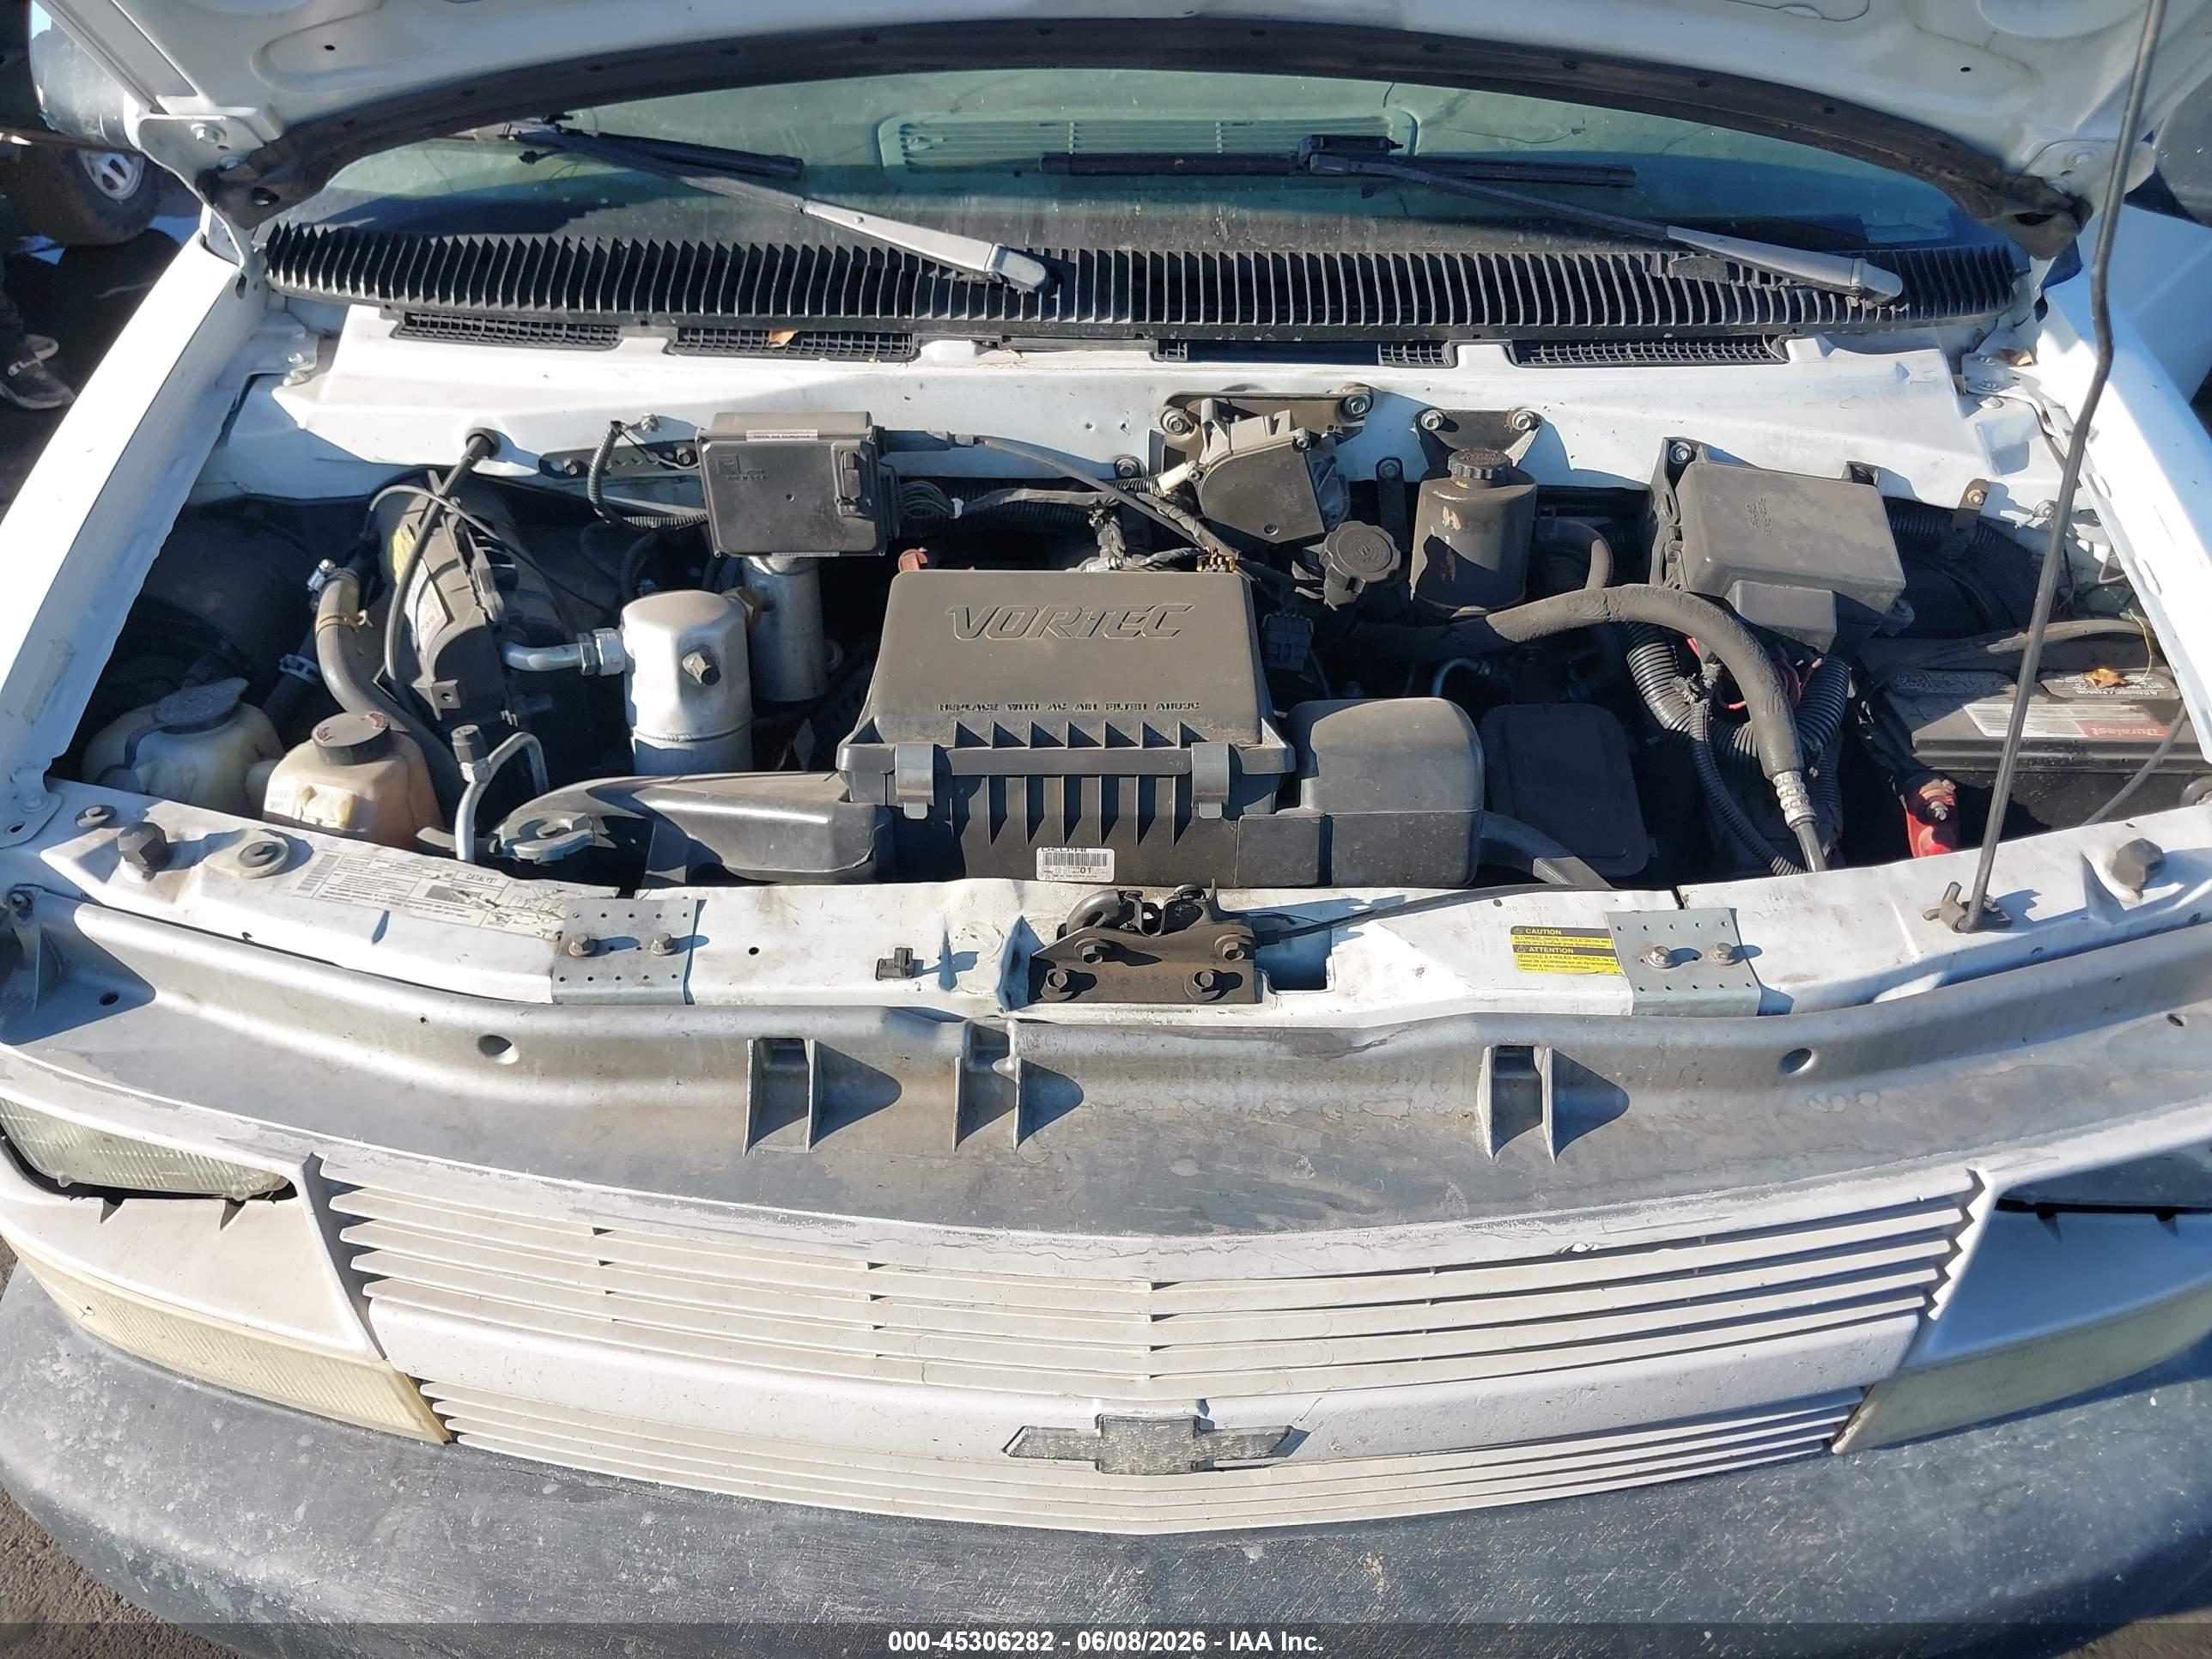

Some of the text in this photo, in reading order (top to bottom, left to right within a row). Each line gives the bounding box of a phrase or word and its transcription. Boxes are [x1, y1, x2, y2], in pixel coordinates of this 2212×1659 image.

[945, 605, 1195, 640] VORTEC
[1047, 702, 1066, 712] AC
[1074, 702, 1097, 712] AIR
[1105, 702, 1147, 712] FILTER
[2090, 727, 2164, 738] Duralast
[466, 873, 498, 884] CATALYST
